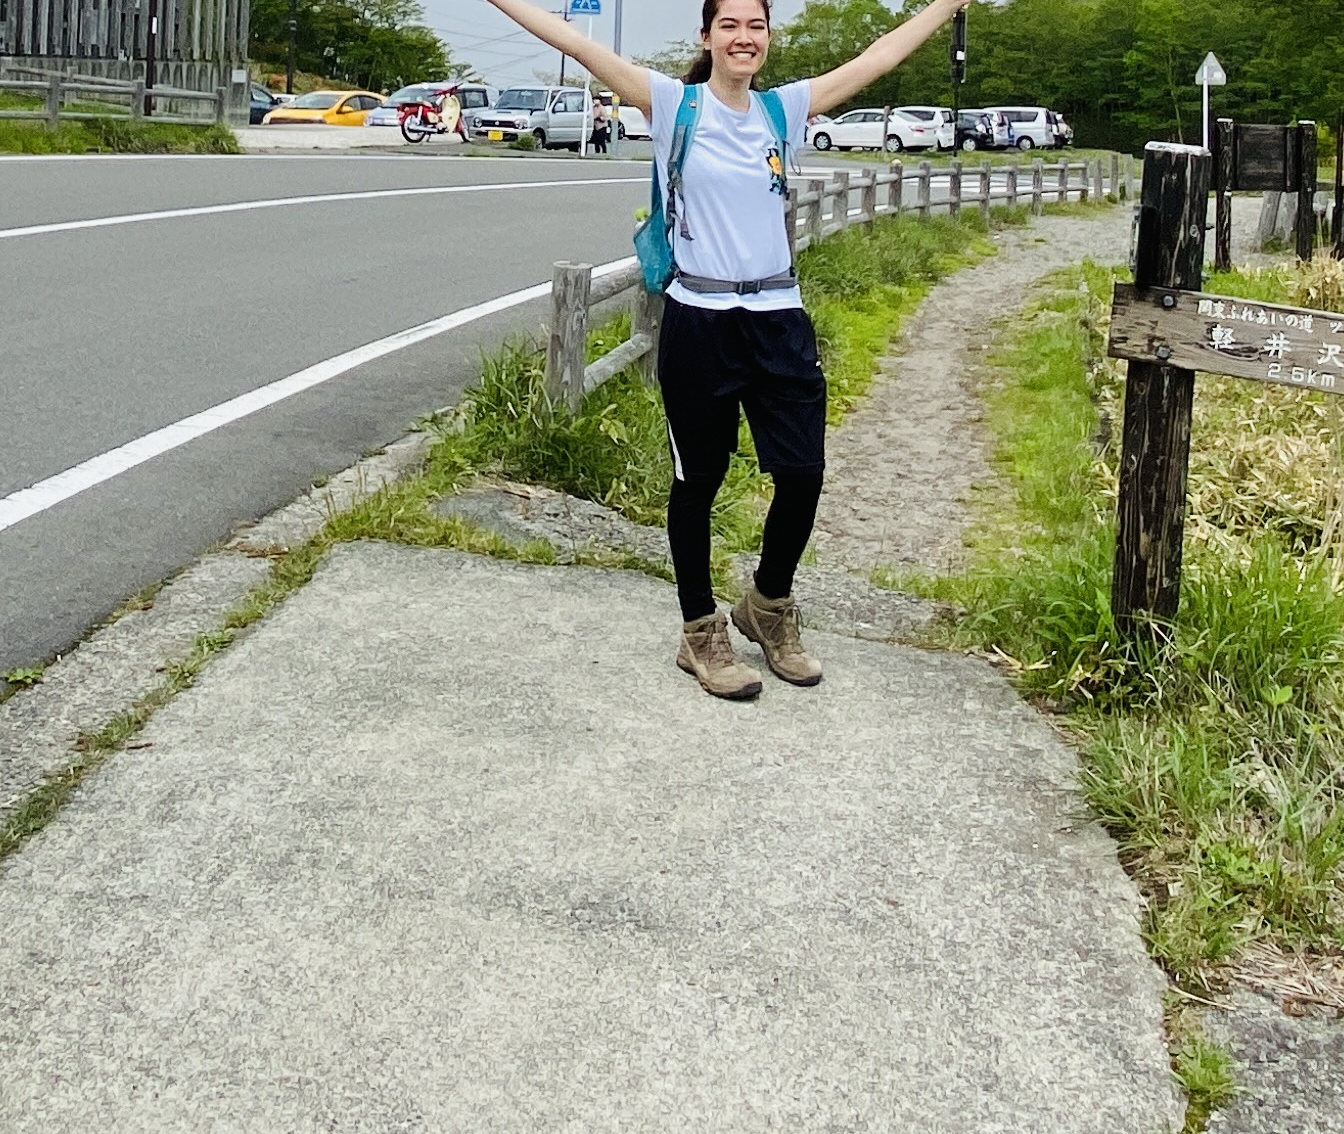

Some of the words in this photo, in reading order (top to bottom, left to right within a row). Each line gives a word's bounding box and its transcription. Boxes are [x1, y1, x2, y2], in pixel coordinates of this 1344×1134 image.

[1197, 299, 1314, 333] 関東ふれあいの道
